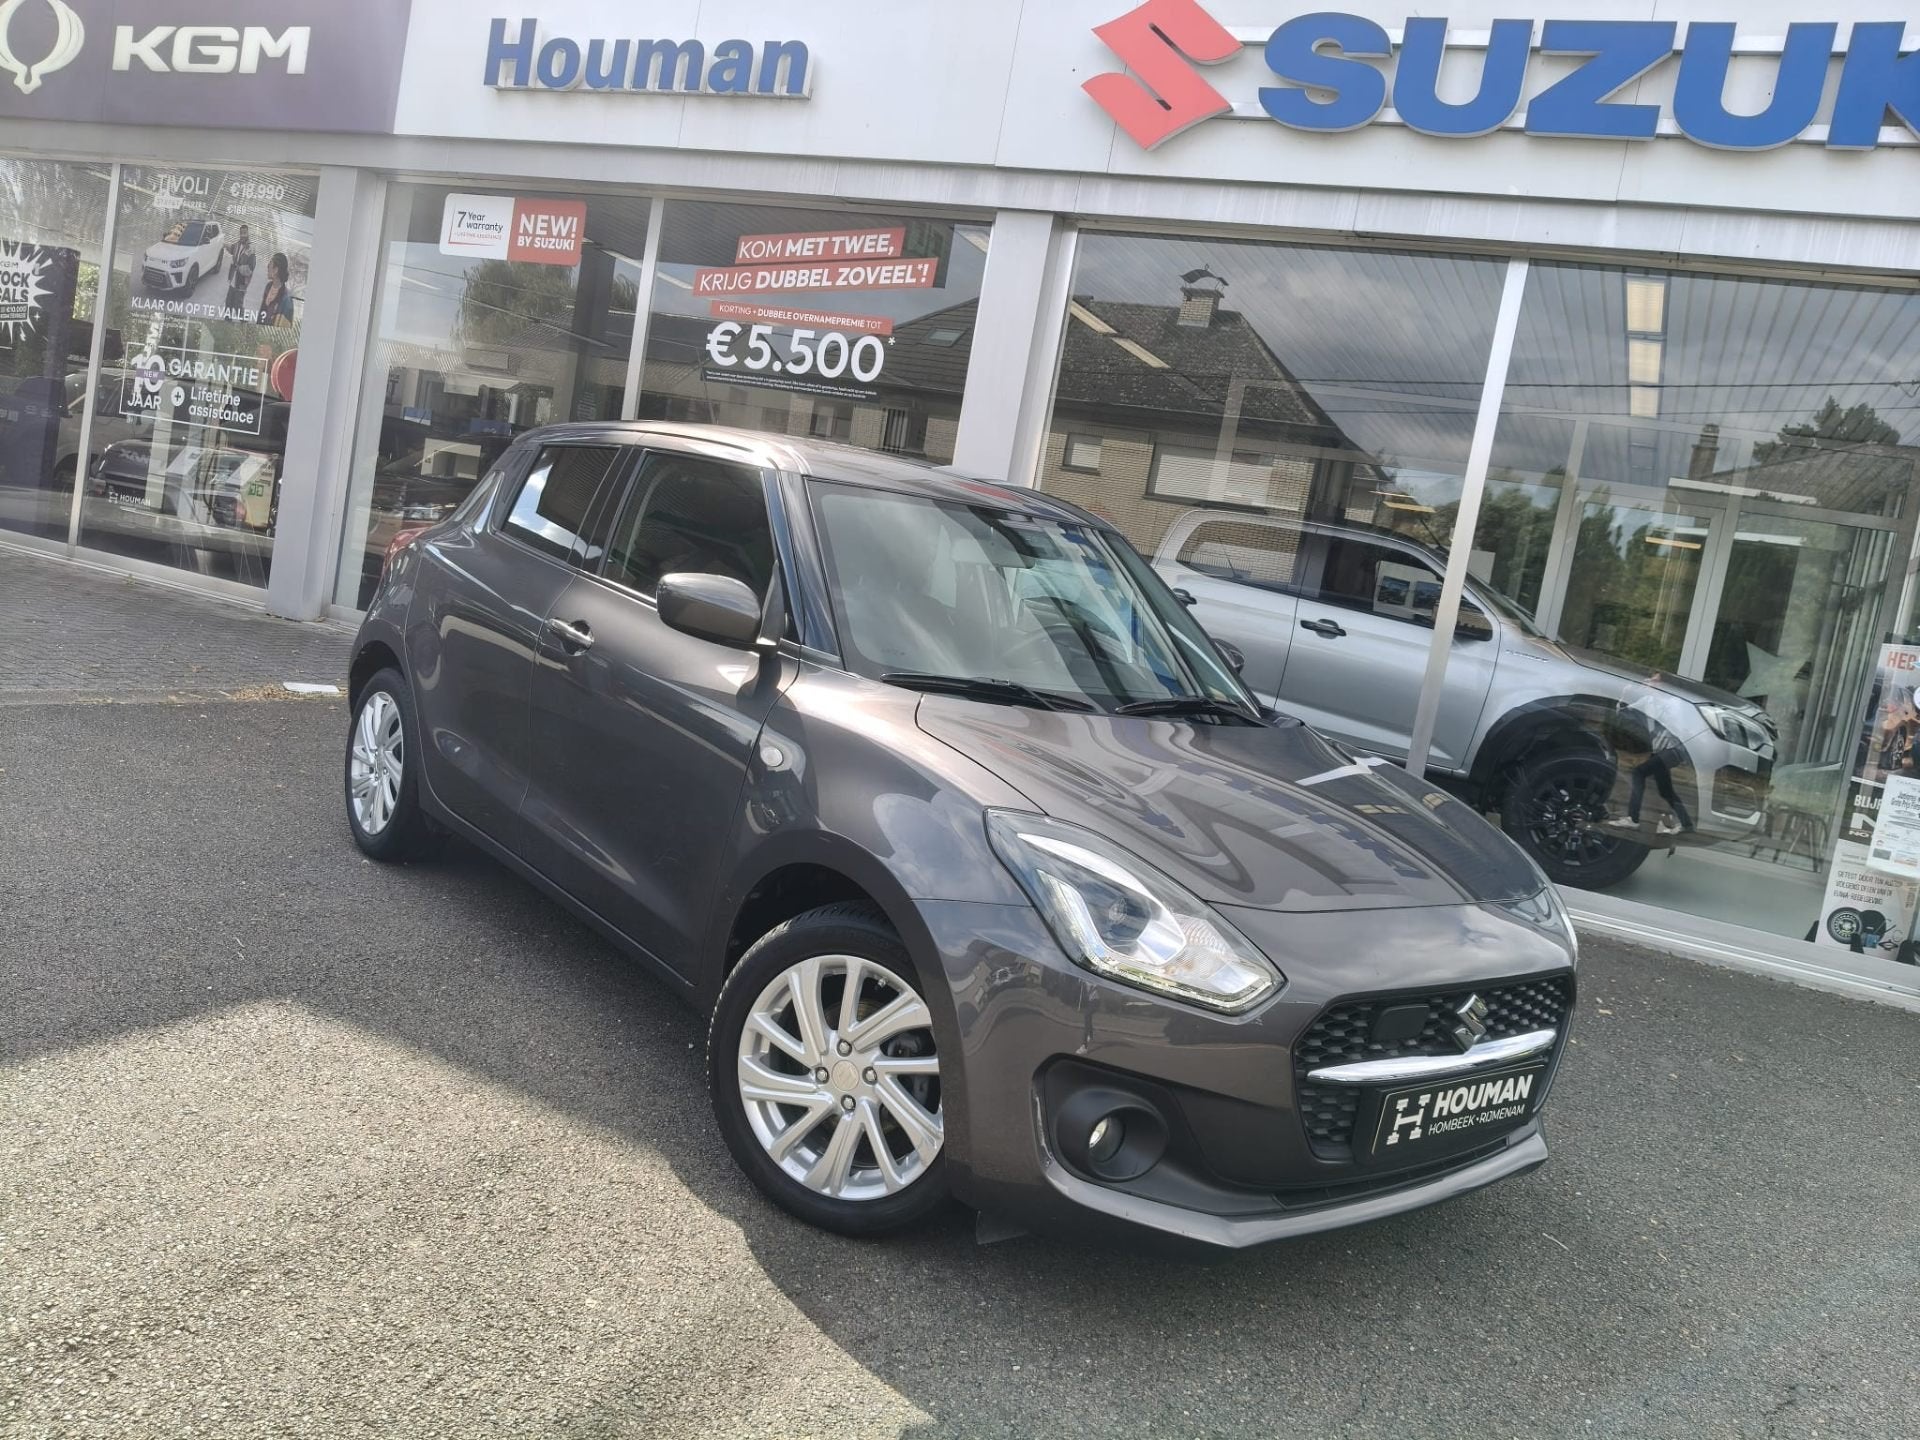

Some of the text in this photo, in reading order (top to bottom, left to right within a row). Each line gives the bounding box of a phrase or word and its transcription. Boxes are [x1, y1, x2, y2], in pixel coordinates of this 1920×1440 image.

[112, 25, 311, 74] KGM
[484, 18, 811, 96] Houman
[158, 174, 210, 195] TIVOLI
[457, 211, 467, 228] 7
[468, 211, 485, 221] Year
[519, 213, 578, 239] NEW!
[466, 222, 503, 233] warranty
[517, 236, 575, 250] BY SUZUKI
[739, 234, 894, 259] KOM MET TWEE,
[0, 271, 30, 288] OCK
[700, 272, 752, 291] KRIJG
[755, 268, 832, 289] DUBBEL
[131, 297, 165, 310] KLAAR
[167, 301, 183, 313] OM
[186, 302, 200, 314] OP
[203, 304, 215, 316] TE
[218, 306, 259, 322] VALLEN
[719, 304, 751, 315] KORTING
[757, 308, 792, 320] DUBBELE
[793, 313, 865, 328] OVERNAMEPREMIE
[866, 320, 882, 329] TOT
[131, 353, 165, 393] 10
[143, 370, 159, 378] NEW
[169, 358, 259, 386] GARANTIE
[127, 392, 162, 410] JAAR
[190, 387, 241, 406] Lifetime
[188, 405, 254, 424] assistance
[119, 493, 151, 506] HOUMAN
[1432, 1074, 1533, 1118] HOUMAN
